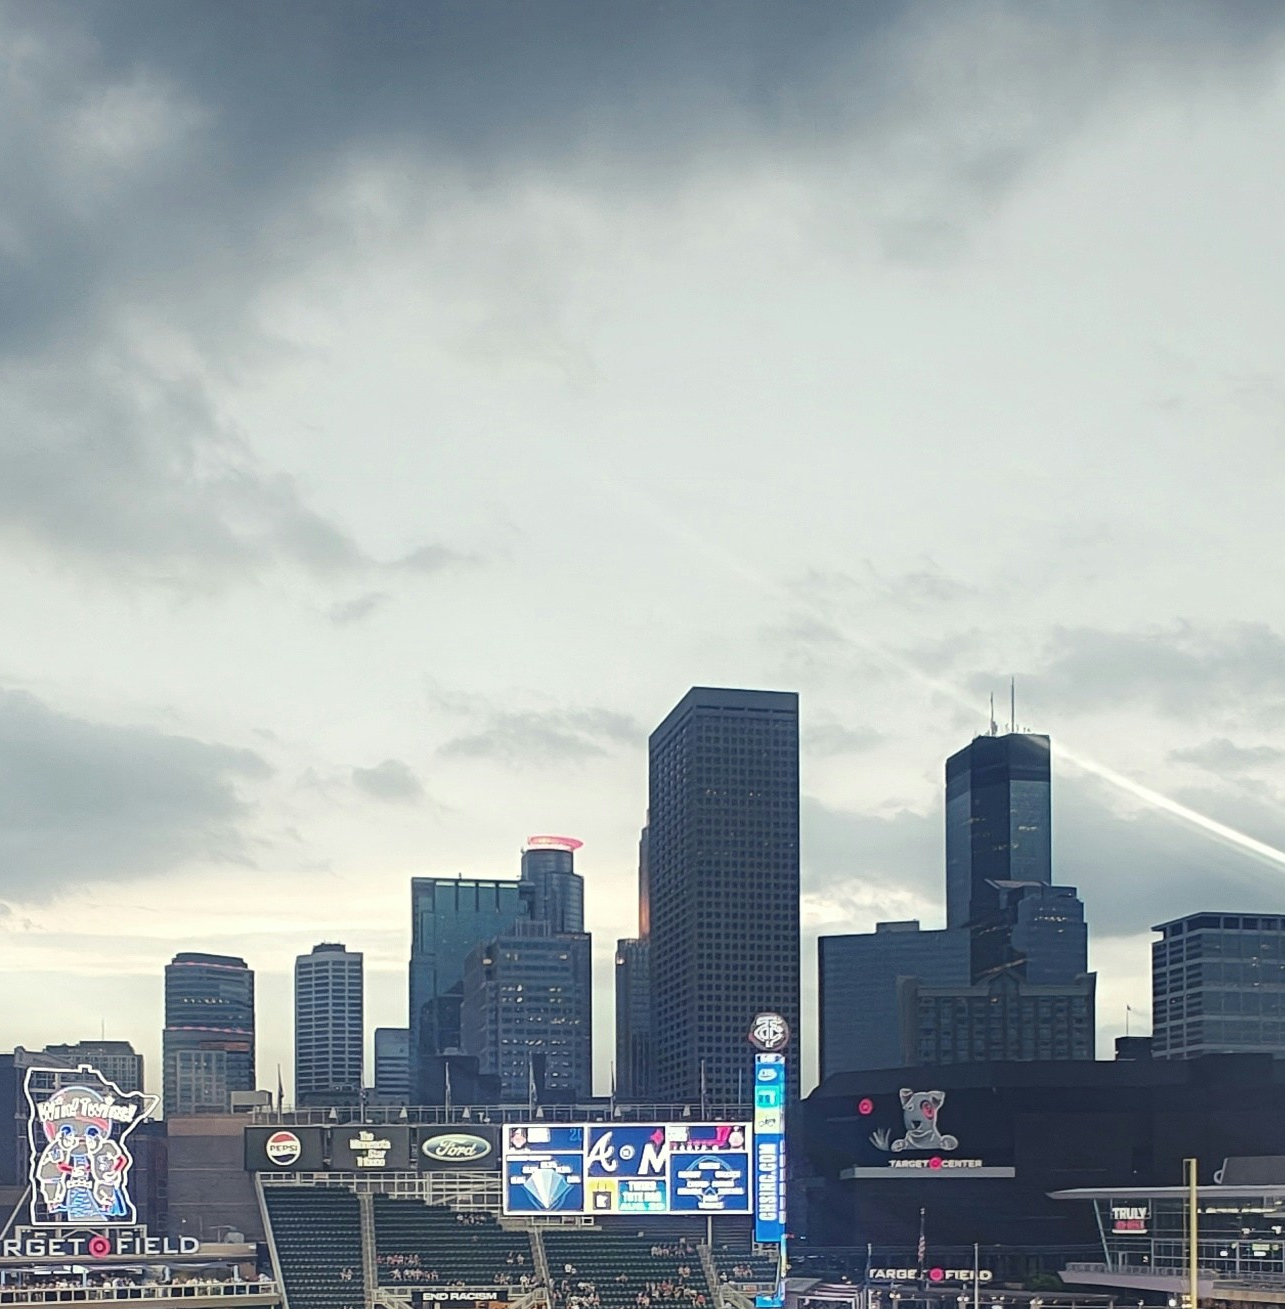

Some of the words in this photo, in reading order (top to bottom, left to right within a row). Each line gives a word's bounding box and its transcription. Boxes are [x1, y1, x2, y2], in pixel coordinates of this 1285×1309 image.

[270, 1144, 298, 1152] PEPSI
[435, 1140, 477, 1157] Ford
[889, 1160, 928, 1168] TARGET
[941, 1160, 982, 1168] CENTER
[758, 1143, 777, 1221] CHSINC.COM
[1112, 1207, 1147, 1219] TRULY
[116, 1236, 200, 1255] FIELD
[422, 1292, 449, 1301] END
[450, 1292, 498, 1301] RACISM
